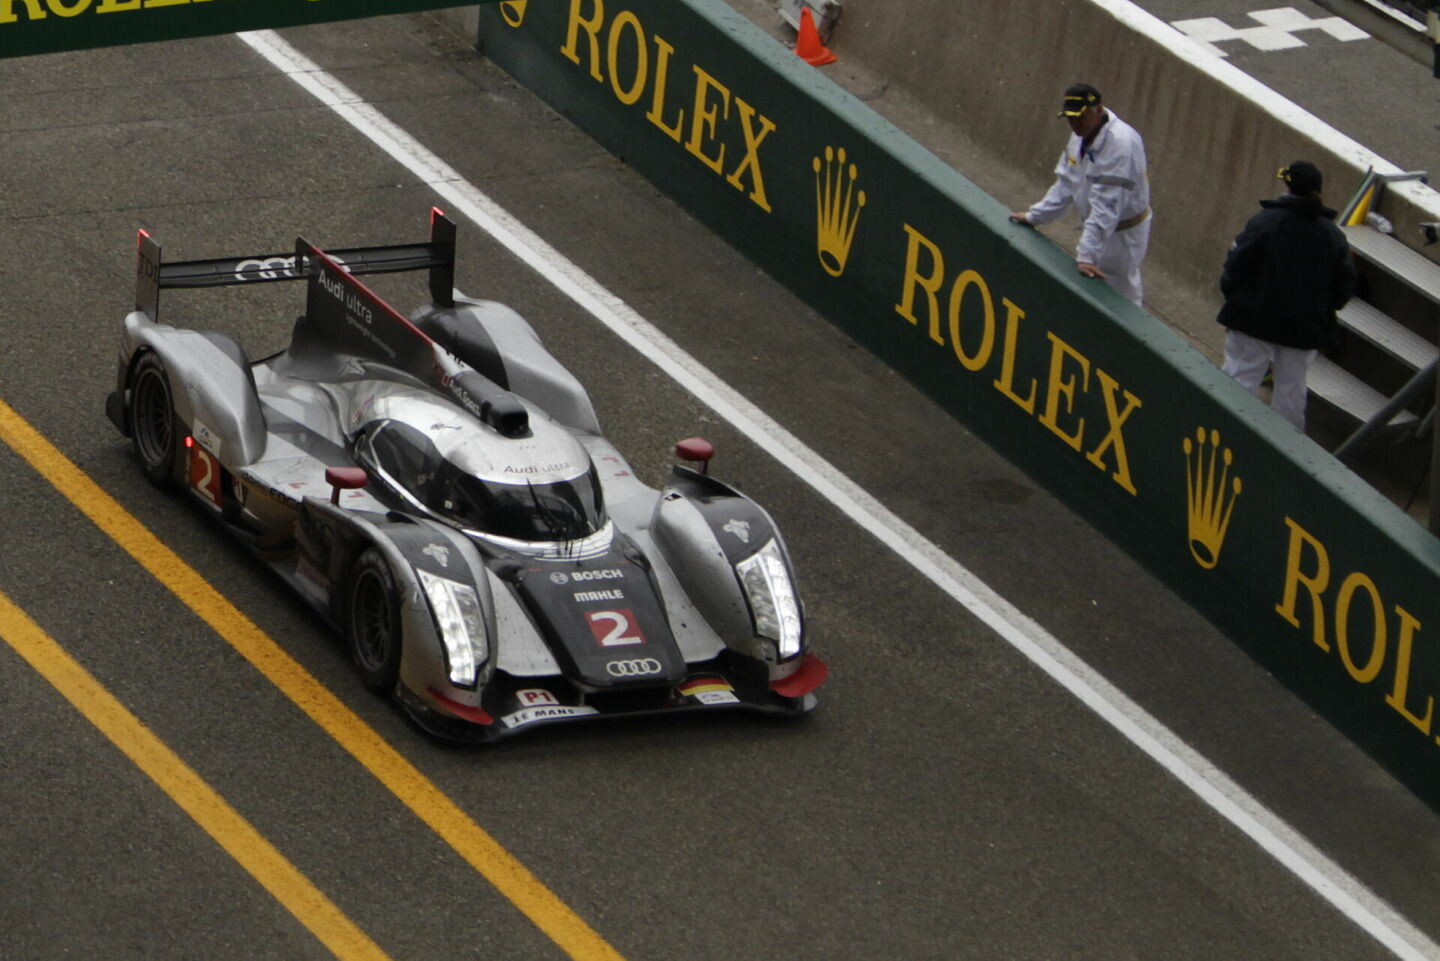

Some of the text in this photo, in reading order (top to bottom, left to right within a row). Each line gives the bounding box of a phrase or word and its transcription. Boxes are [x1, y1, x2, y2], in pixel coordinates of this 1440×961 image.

[318, 269, 372, 324] Audi ultra
[895, 223, 1142, 496] ROLEX
[197, 450, 216, 502] 2
[503, 464, 538, 474] Audi
[571, 569, 624, 581] BOSCH
[574, 589, 624, 602] MAHLE
[591, 611, 641, 646] 2
[1275, 516, 1440, 746] ROL
[523, 691, 553, 704] P1
[535, 708, 575, 718] MANS
